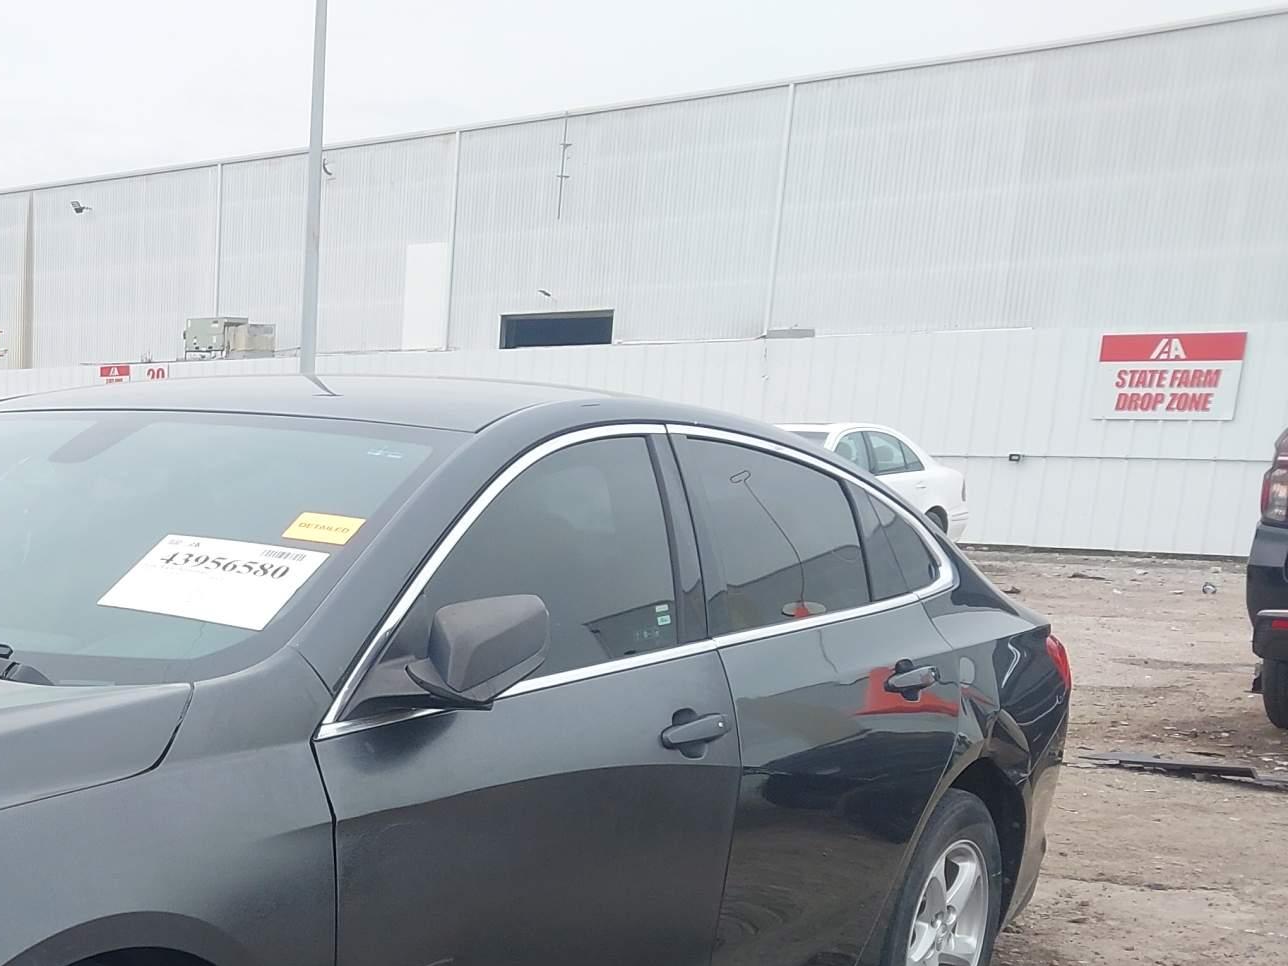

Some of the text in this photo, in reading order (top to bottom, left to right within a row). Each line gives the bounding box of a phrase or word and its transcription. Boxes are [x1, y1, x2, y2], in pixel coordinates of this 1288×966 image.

[1114, 368, 1223, 388] STATE FARM
[1114, 392, 1215, 411] DROP ZONE
[159, 551, 290, 580] 43956580
